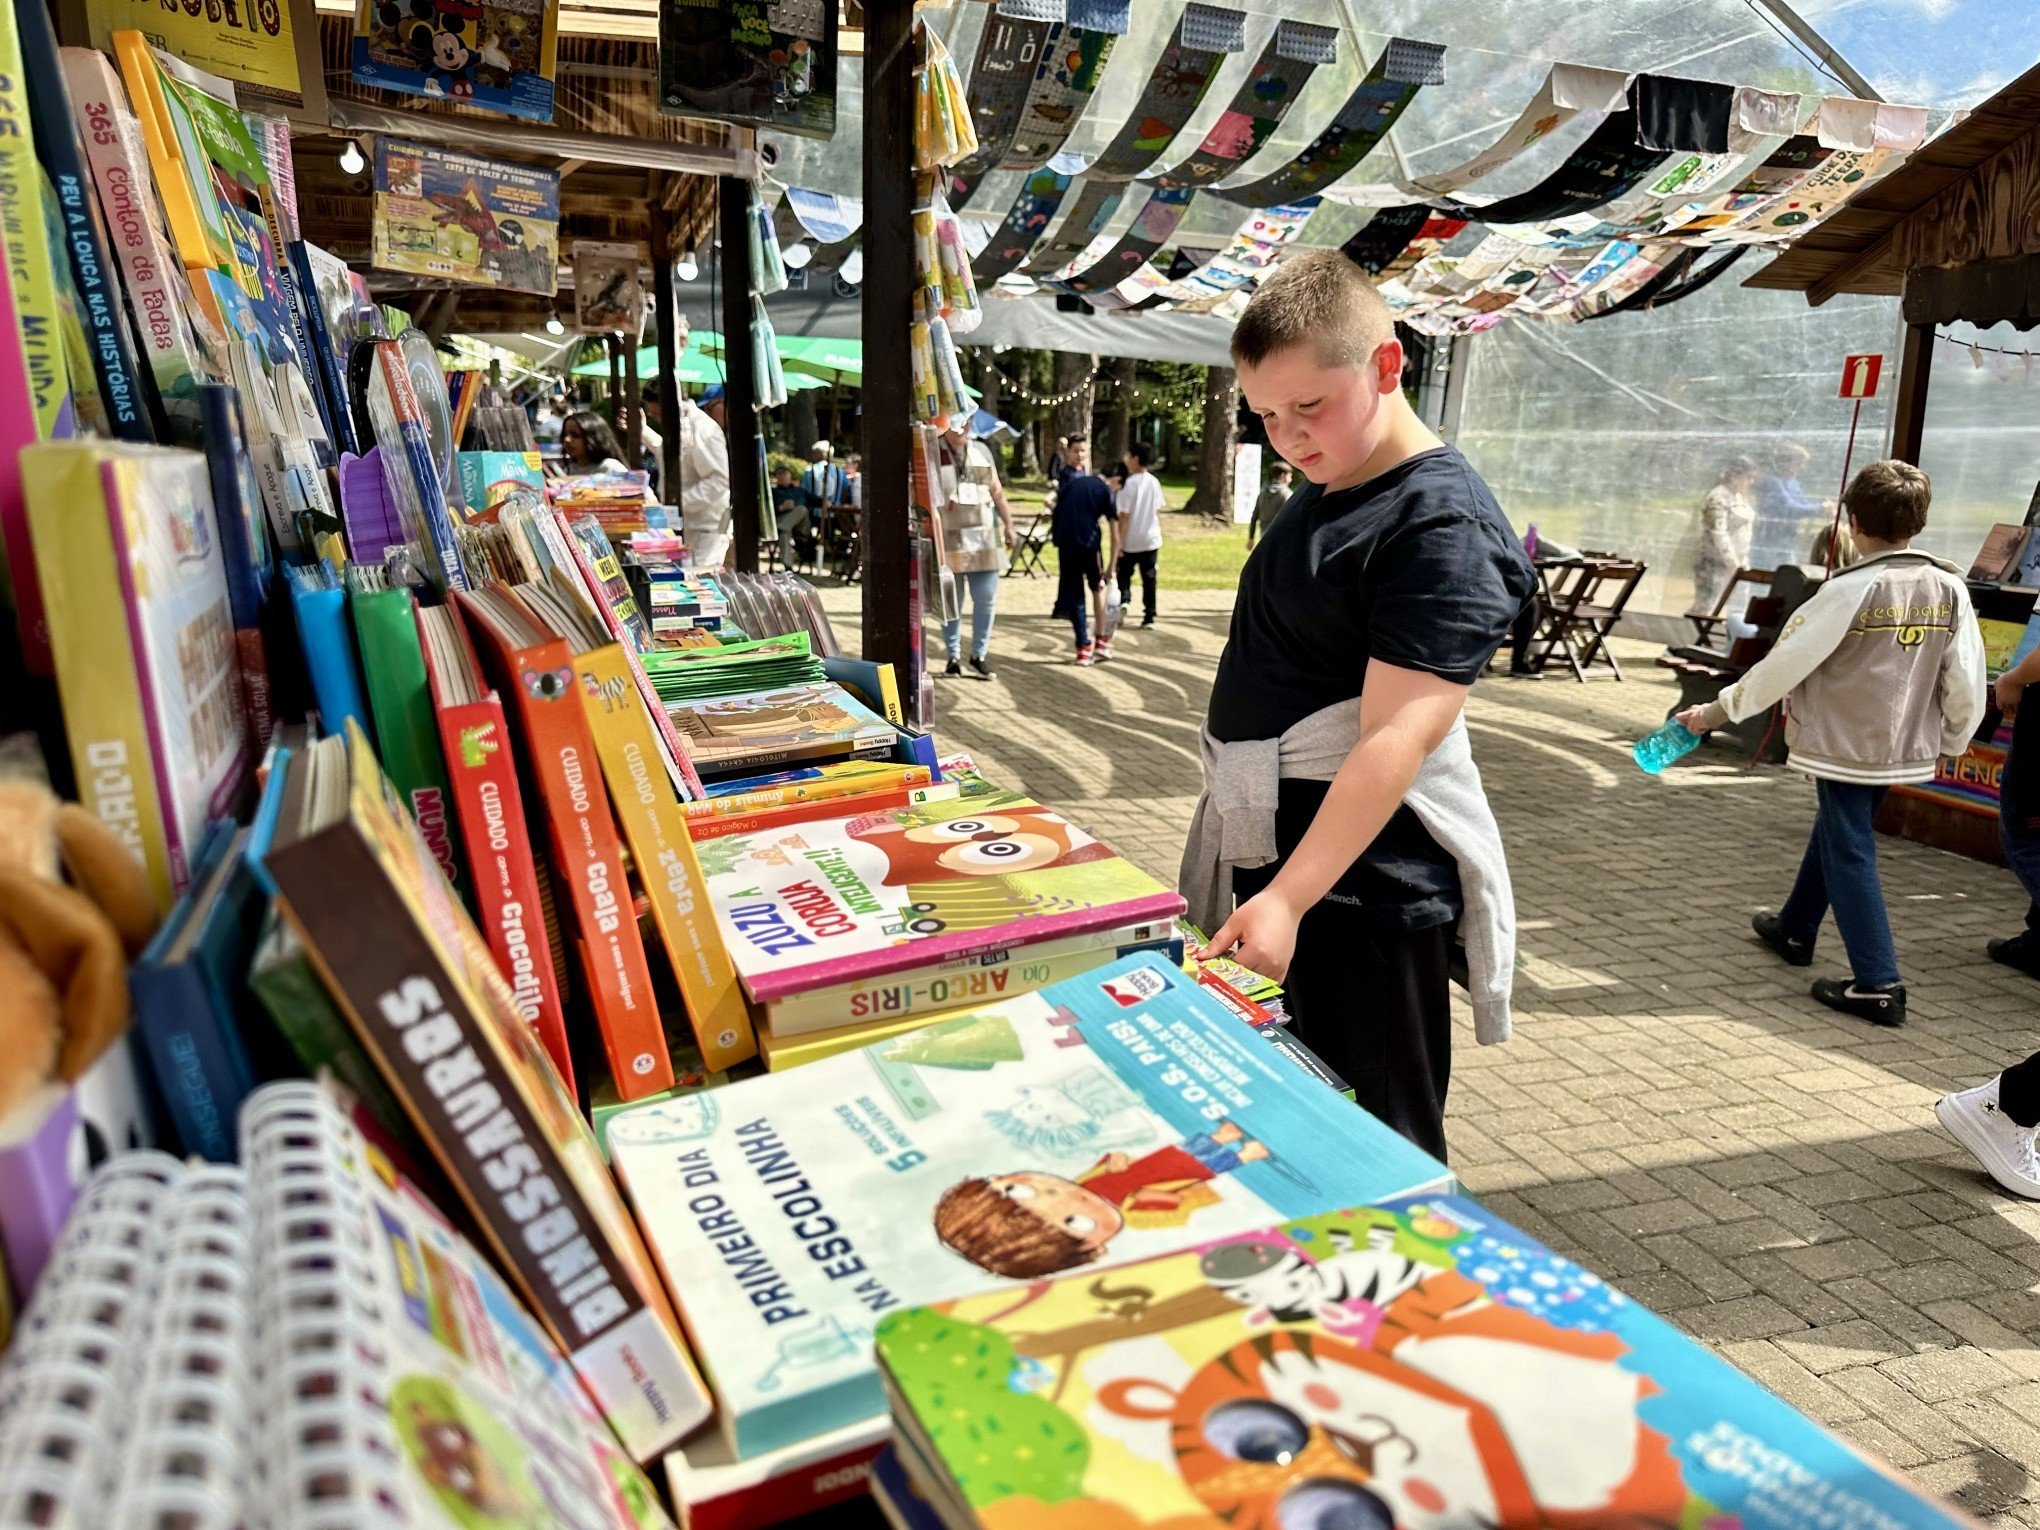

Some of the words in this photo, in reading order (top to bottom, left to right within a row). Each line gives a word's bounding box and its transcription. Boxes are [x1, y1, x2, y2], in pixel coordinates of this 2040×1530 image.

[84, 101, 116, 146] 365
[68, 212, 85, 229] A
[105, 166, 143, 248] Contos
[268, 213, 284, 260] DESCUBRA
[71, 233, 96, 290] LOUCA
[132, 254, 153, 282] de
[88, 291, 111, 331] NAS
[141, 288, 173, 351] Fadas
[98, 332, 136, 424] HISTÓRIAS
[261, 461, 278, 493] Apague
[273, 502, 290, 534] Escreva
[440, 549, 458, 577] UMA
[250, 674, 266, 708] SOLAR
[859, 740, 874, 748] Books
[875, 737, 892, 745] Happy
[622, 743, 657, 803] CUIDADO
[717, 758, 744, 768] GREGA
[747, 752, 788, 766] MITOLOGIA
[559, 747, 591, 815] CUIDADO
[686, 800, 713, 816] MAR
[716, 799, 731, 811] do
[734, 790, 784, 808] Animais
[479, 780, 510, 851] CUIDADO
[495, 855, 510, 888] com
[579, 817, 595, 849] com
[645, 808, 663, 839] com
[698, 827, 709, 836] Oz
[711, 824, 724, 834] de
[726, 820, 750, 834] Mágico
[658, 846, 695, 917] zebra
[728, 885, 762, 899] A
[777, 878, 857, 938] CORUJA
[1324, 891, 1362, 906] Bench.
[688, 930, 702, 956] seus
[728, 902, 818, 956] ZUZU
[612, 946, 625, 972] seus
[694, 955, 716, 989] amigos!
[982, 949, 1007, 965] SELVA
[616, 973, 636, 1011] amigos!
[850, 969, 1009, 1018] ARCO-ÍRIS
[1236, 1009, 1255, 1022] DE
[1105, 1019, 1166, 1066] PAIS!
[1159, 1062, 1231, 1120] S.O.S.
[380, 974, 631, 1336] DINOSSAUROS
[677, 1147, 721, 1188] DIA
[887, 1149, 927, 1172] 5
[734, 1116, 869, 1282] ESCOLINHA
[689, 1198, 810, 1327] PRIMEIRO
[854, 1276, 900, 1314] NA
